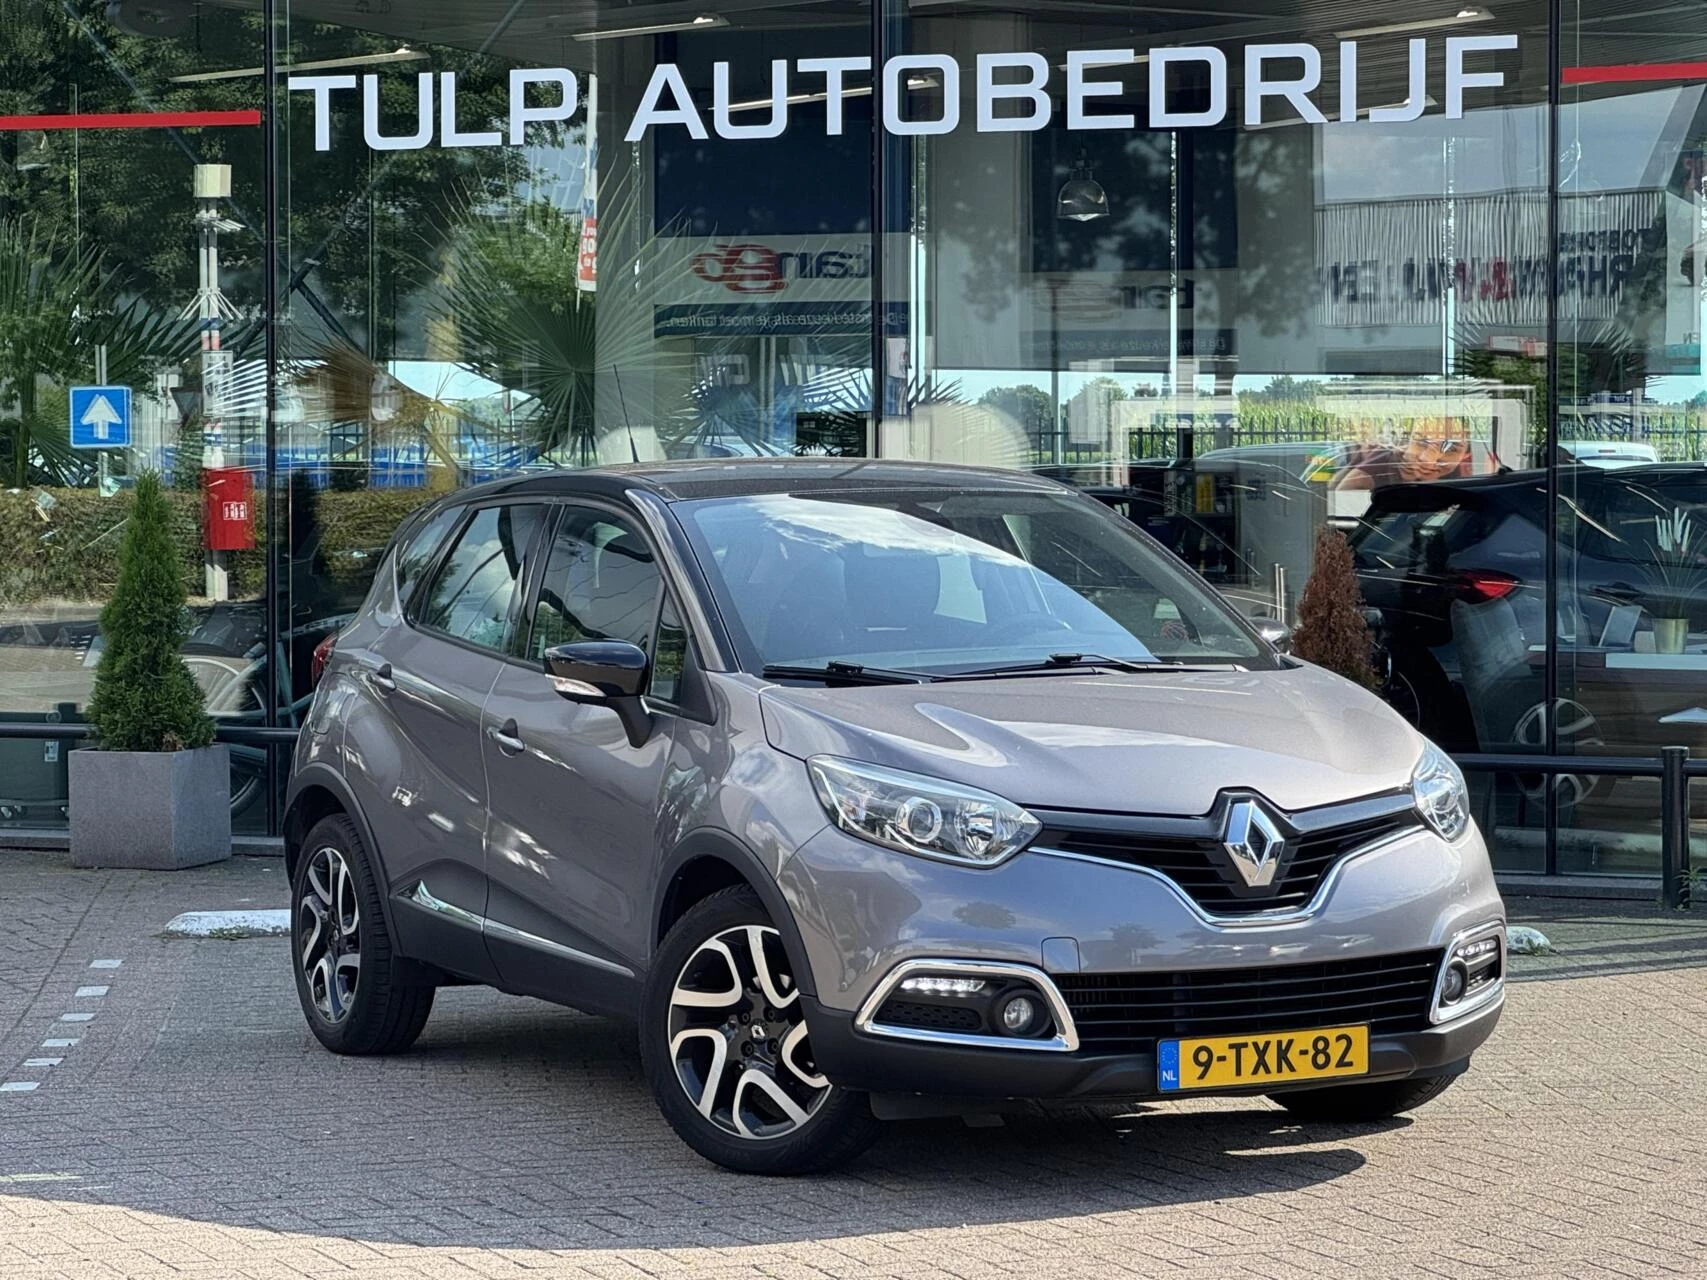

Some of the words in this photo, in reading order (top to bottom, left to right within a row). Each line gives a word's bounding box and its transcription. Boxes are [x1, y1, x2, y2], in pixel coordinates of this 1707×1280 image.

[288, 68, 577, 151] TULP
[624, 34, 1518, 142] AUTOBEDRIJF
[1162, 1070, 1177, 1081] NL
[1193, 1033, 1354, 1081] 9-TXK-82
